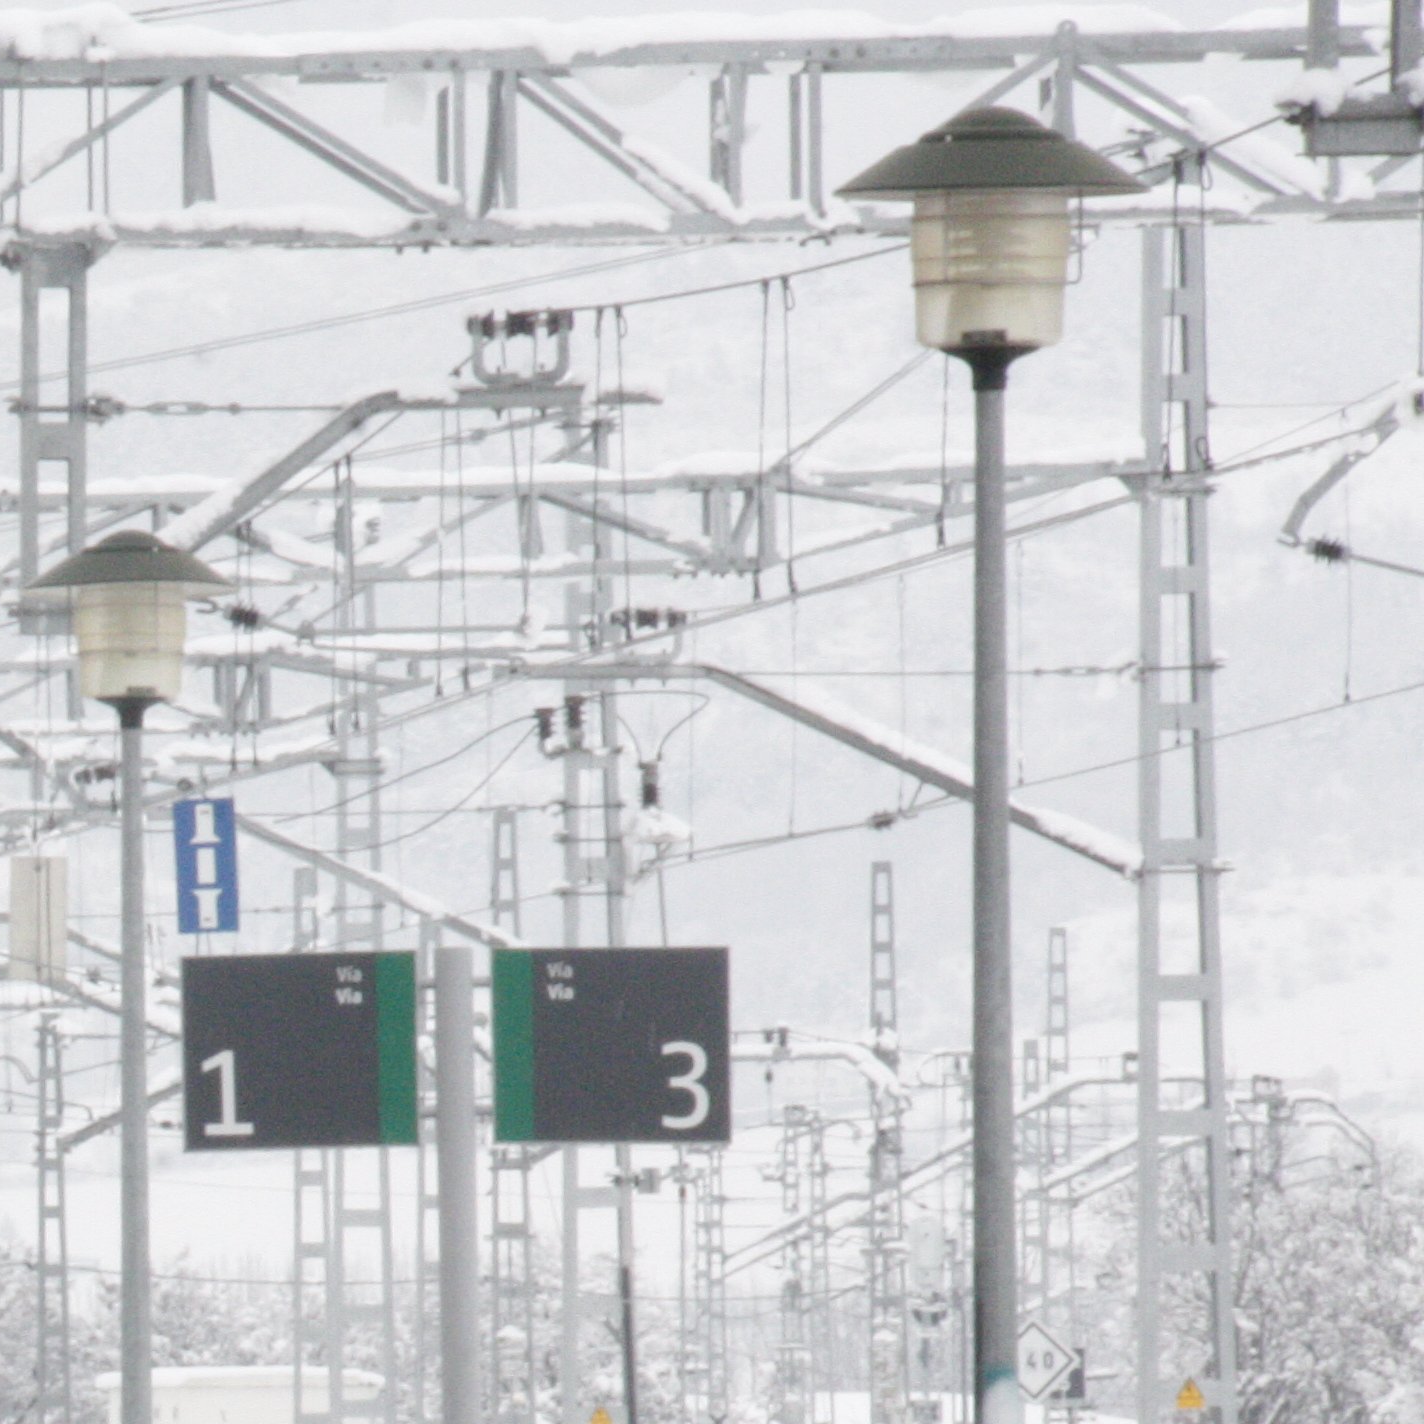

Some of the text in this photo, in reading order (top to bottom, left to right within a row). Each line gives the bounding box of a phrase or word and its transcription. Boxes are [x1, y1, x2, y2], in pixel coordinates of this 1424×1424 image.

[200, 1048, 255, 1137] 1
[660, 1040, 711, 1130] 3
[1027, 1351, 1054, 1369] 40
